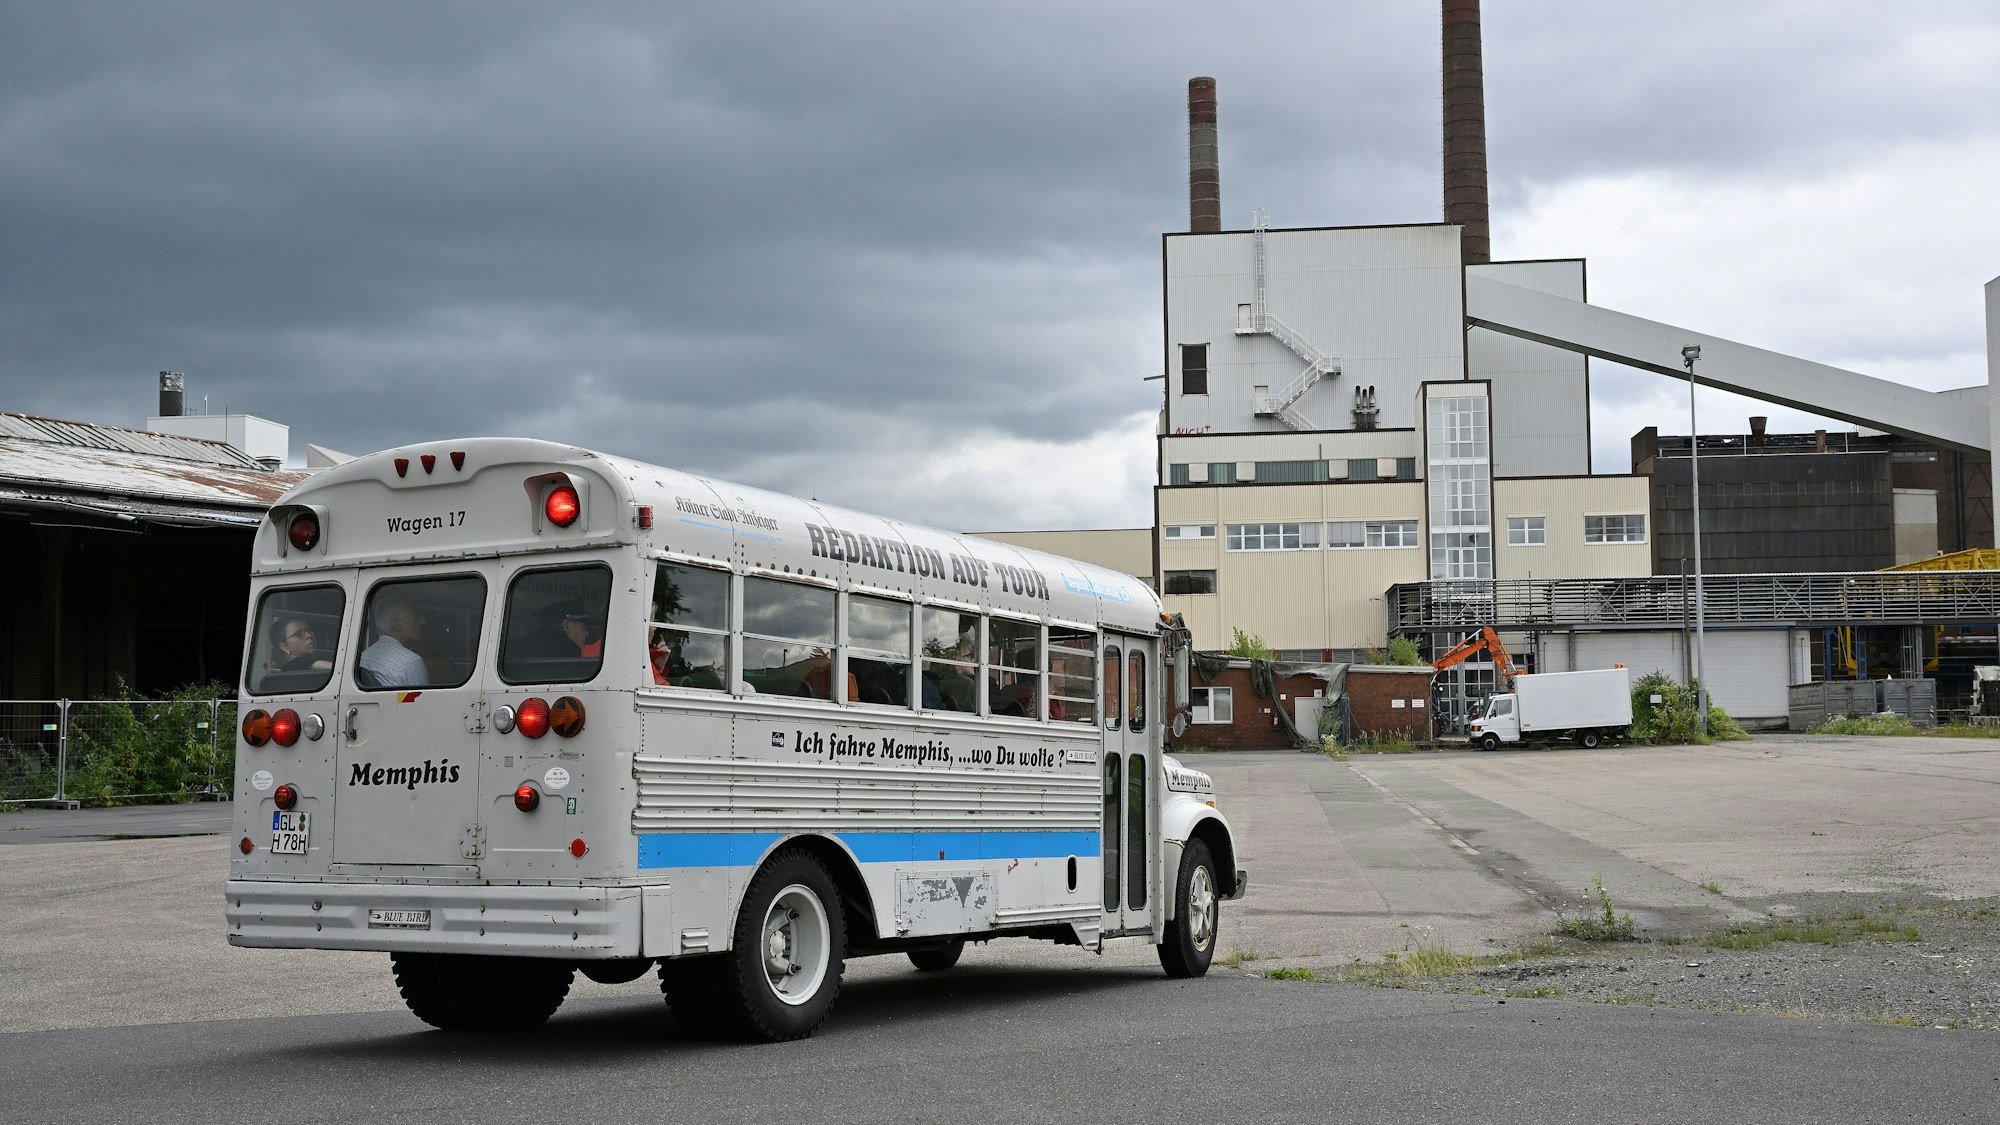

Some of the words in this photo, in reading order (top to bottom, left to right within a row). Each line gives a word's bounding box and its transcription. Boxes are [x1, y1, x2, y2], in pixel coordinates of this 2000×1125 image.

[387, 517, 443, 535] Wagen
[449, 511, 466, 527] 17
[804, 522, 946, 581] REDAKTION
[949, 552, 989, 588] AUF
[992, 561, 1050, 601] TOUR
[794, 730, 824, 754] Ich
[828, 732, 876, 761] fahre
[880, 737, 953, 768] Memphis,
[996, 745, 1015, 766] Du
[349, 758, 460, 790] Memphis
[1171, 769, 1211, 791] Memphis
[280, 814, 296, 831] GL
[271, 833, 281, 850] H
[283, 833, 307, 851] 78H
[384, 911, 405, 922] BLUE
[406, 912, 429, 923] BIRD
